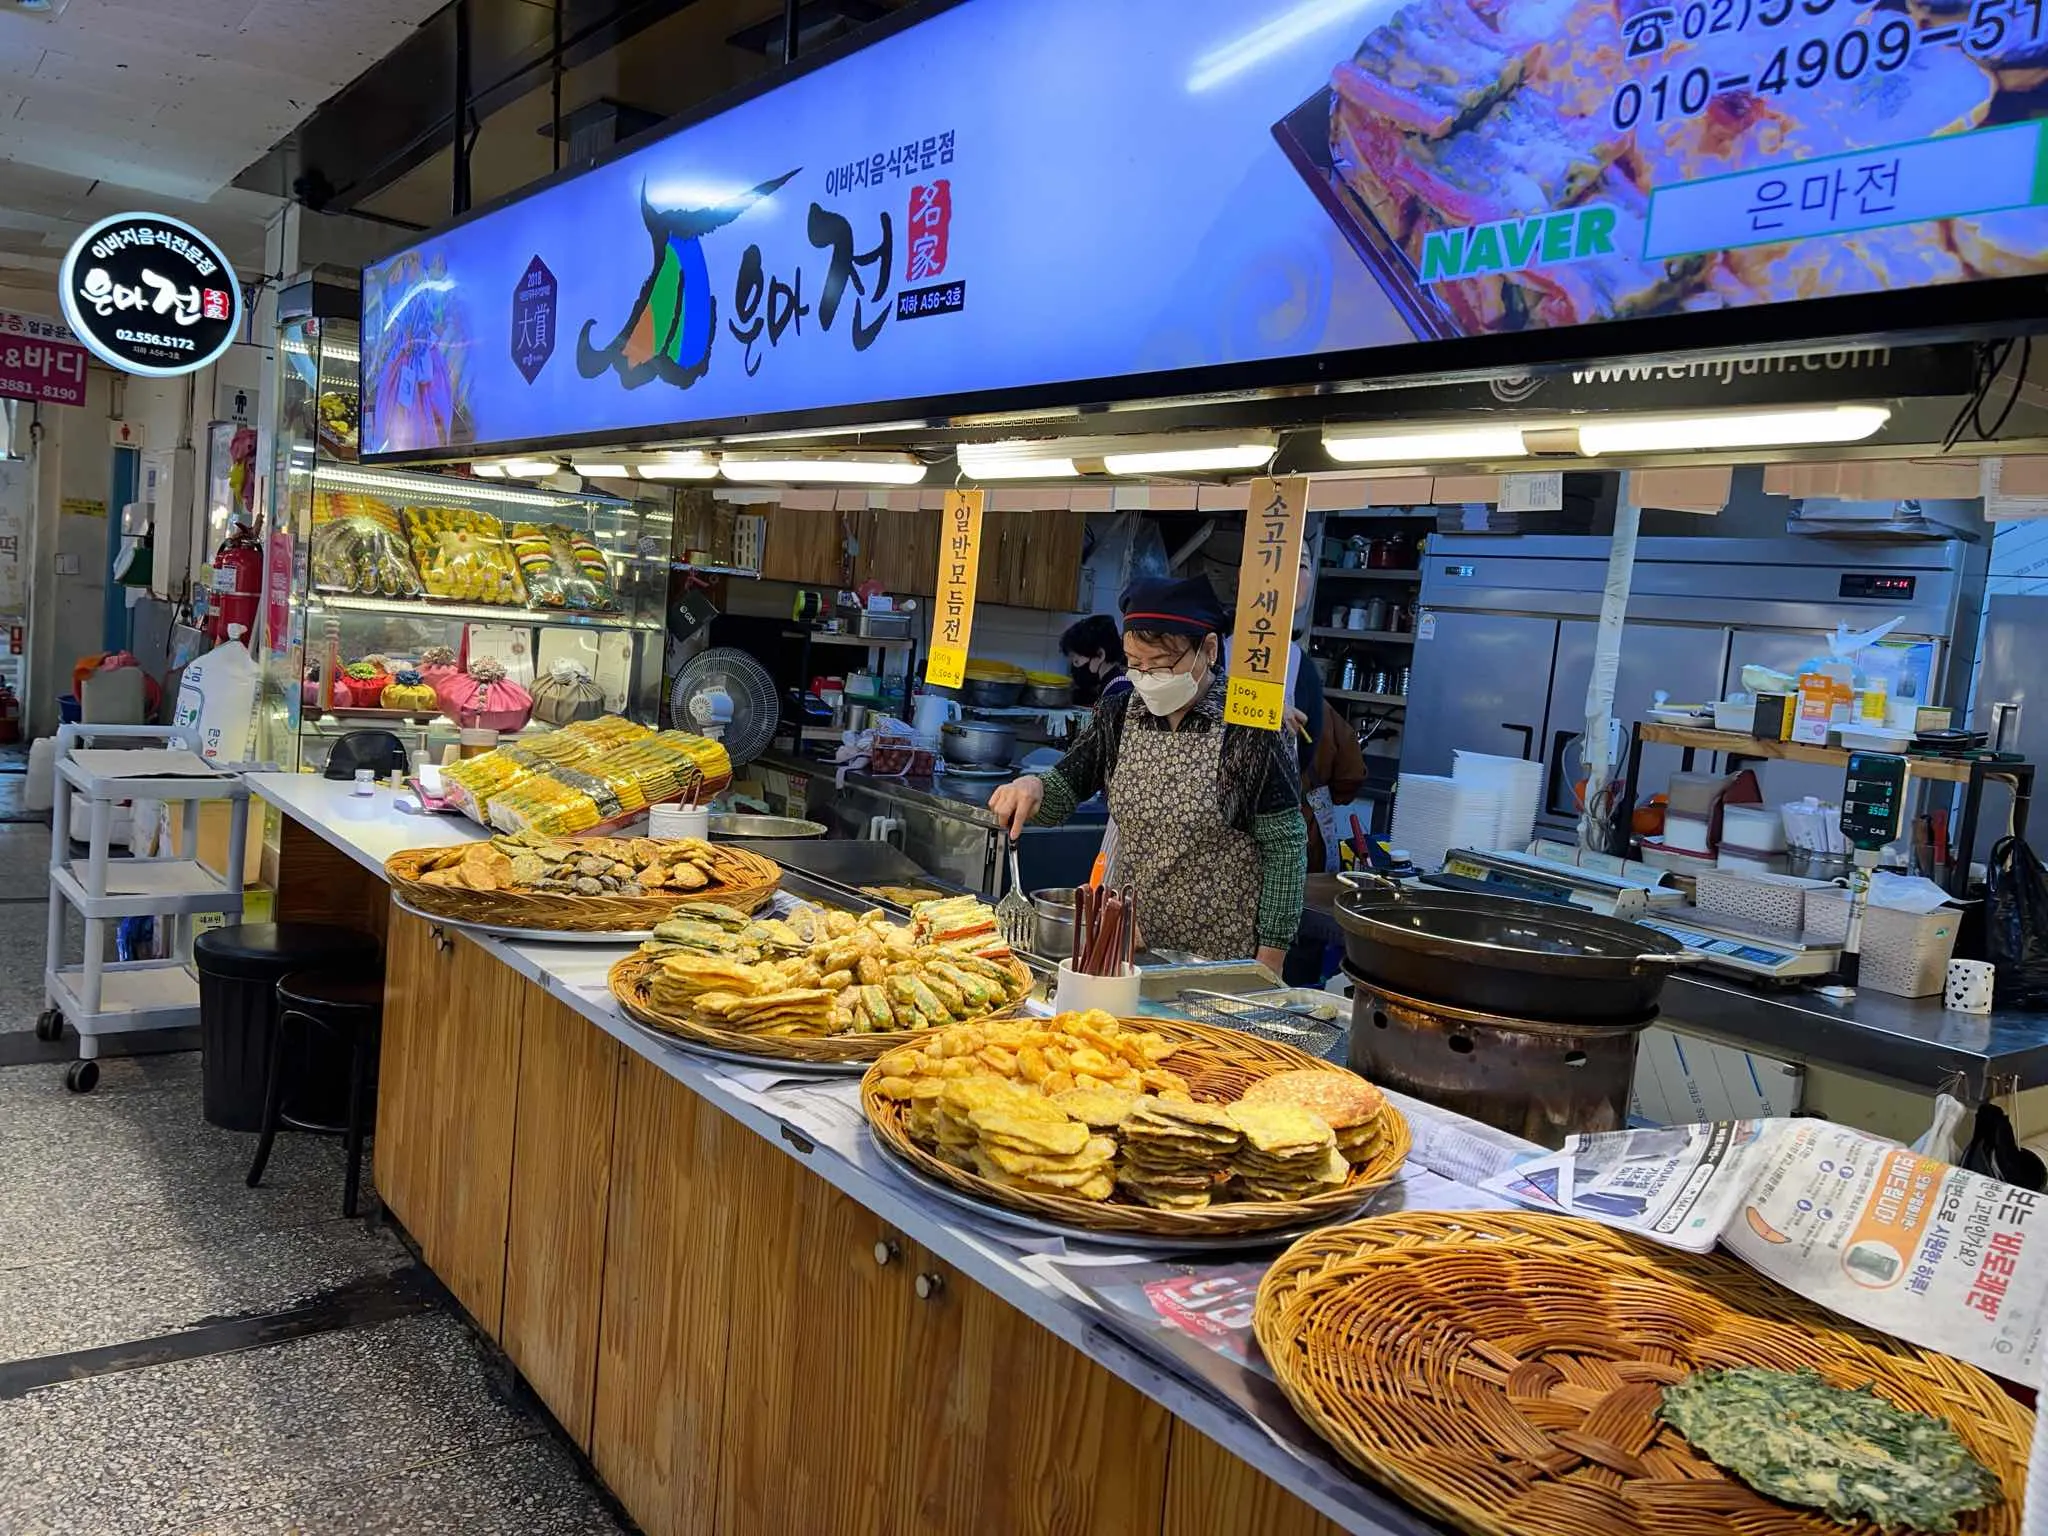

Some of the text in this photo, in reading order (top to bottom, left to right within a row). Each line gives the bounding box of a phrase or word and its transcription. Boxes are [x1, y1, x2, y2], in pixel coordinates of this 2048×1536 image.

[826, 130, 955, 196] 이바지음식전문점
[1747, 159, 1899, 231] 은마전
[91, 228, 218, 276] 이바지음식전문점
[912, 184, 942, 280] 名家
[1422, 210, 1615, 281] NAVER
[80, 268, 202, 326] 은마전
[729, 201, 893, 377] 은마전
[900, 287, 962, 314] 지하 A56-3호
[0, 345, 83, 383] &바디
[115, 329, 195, 350] 02.556.5172
[943, 507, 971, 643] 일반모듬전
[1870, 827, 1886, 836] CAS
[1920, 1224, 1950, 1265] 시원한
[1905, 1264, 1936, 1296] 하루!
